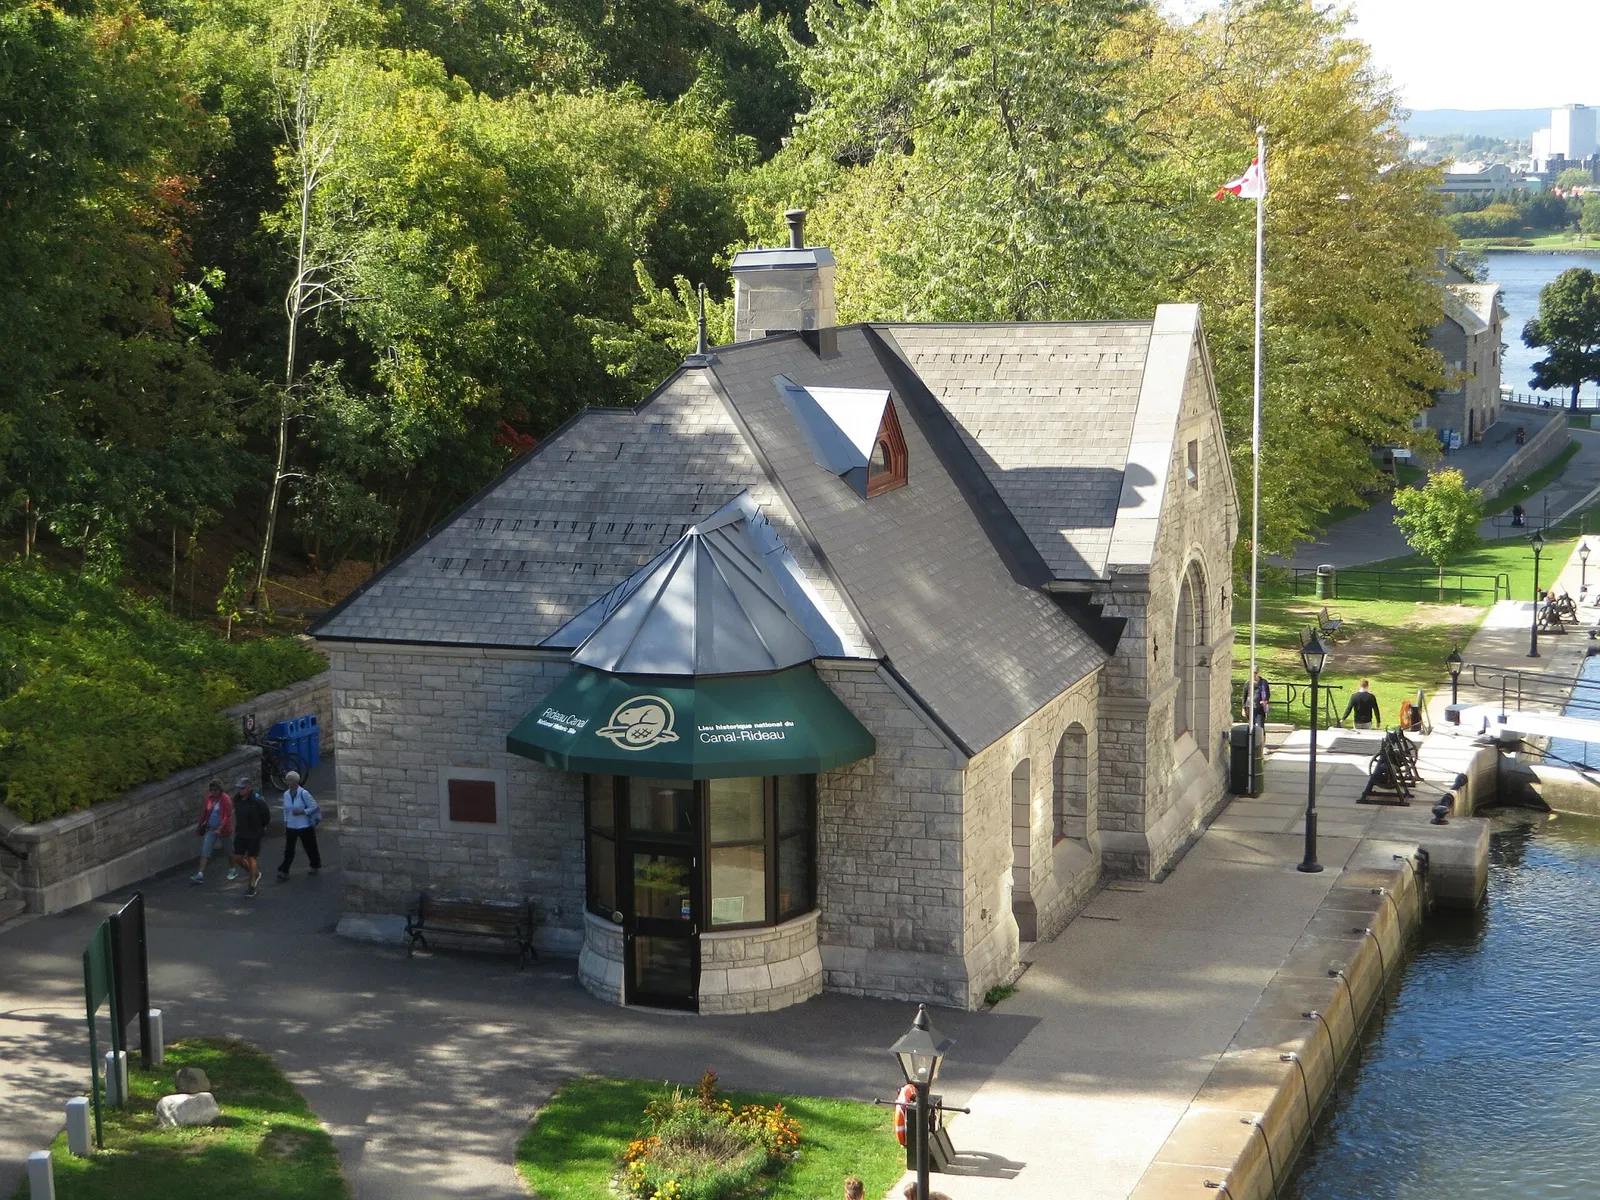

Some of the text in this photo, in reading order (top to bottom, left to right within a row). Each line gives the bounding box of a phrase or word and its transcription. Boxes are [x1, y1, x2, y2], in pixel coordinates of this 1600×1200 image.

[542, 707, 589, 728] Rideau Canal
[700, 730, 785, 743] Canal-Rideau
